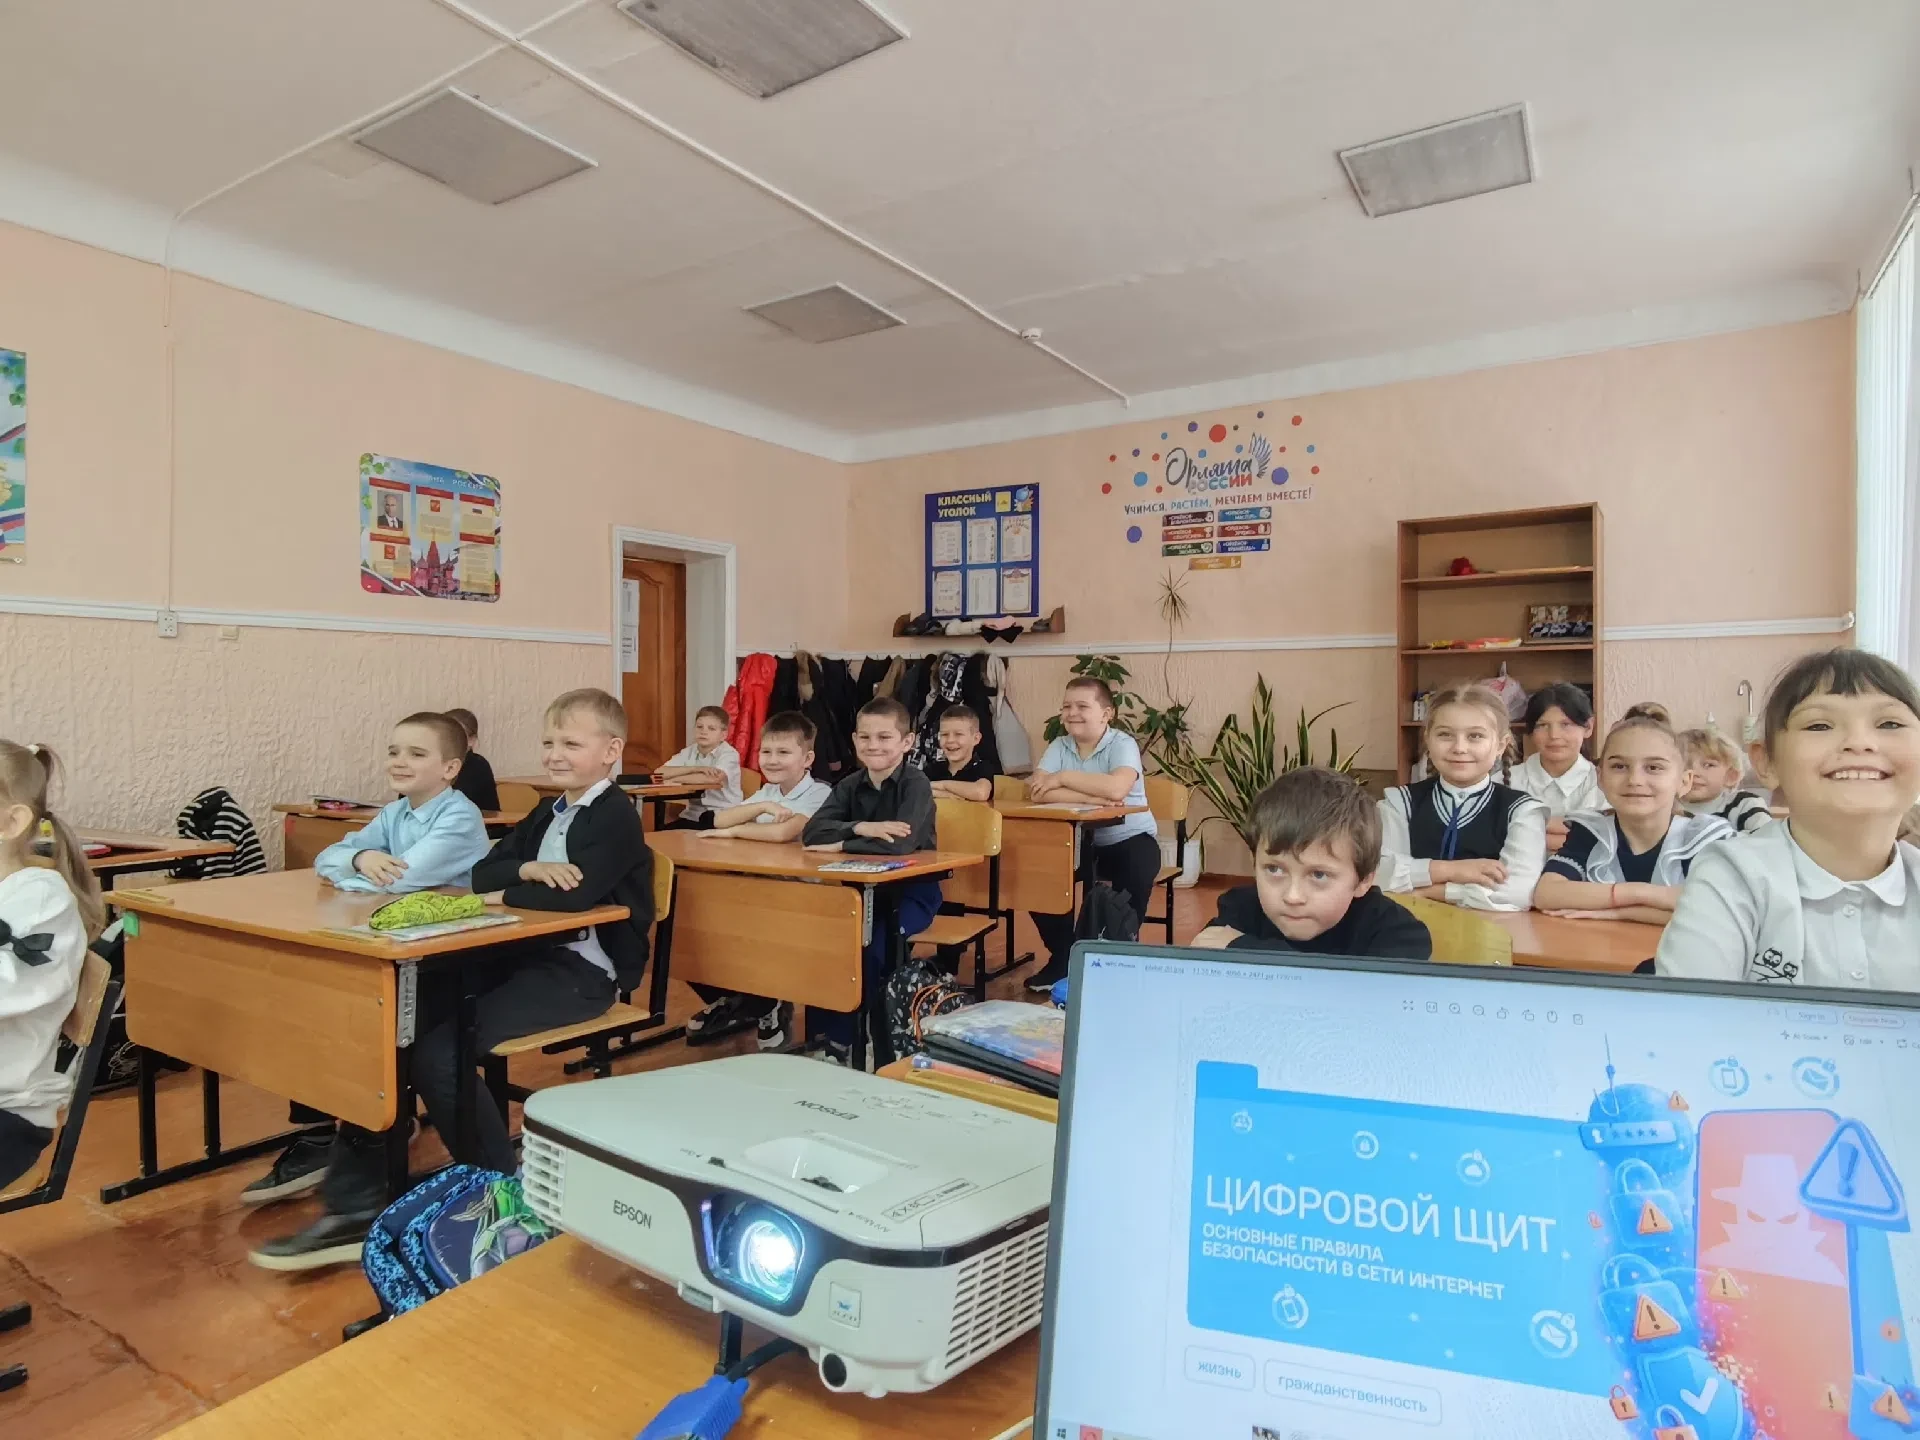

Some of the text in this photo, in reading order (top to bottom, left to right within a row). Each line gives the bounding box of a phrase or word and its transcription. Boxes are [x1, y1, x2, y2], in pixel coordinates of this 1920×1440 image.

[1188, 473, 1253, 493] РОССИИ
[938, 490, 992, 506] КЛАССНЫЙ
[1215, 494, 1262, 506] МЕЧТАЕМ
[1266, 487, 1312, 502] ВМЕСТЕ!
[938, 506, 976, 518] УГОЛОК
[793, 1100, 860, 1120] EPSON
[613, 1199, 652, 1230] EPSON
[1205, 1174, 1557, 1254] ЦИФРОВОЙ ЩИТ
[1202, 1222, 1384, 1264] ОСНОВНЫЕ ПРАВИЛА
[1202, 1240, 1505, 1301] БЕЗОПАСНОСТИ В СЕТИ ИНТЕРНЕТ
[1198, 1360, 1242, 1380] жизнь
[1277, 1374, 1428, 1414] гражданственность
